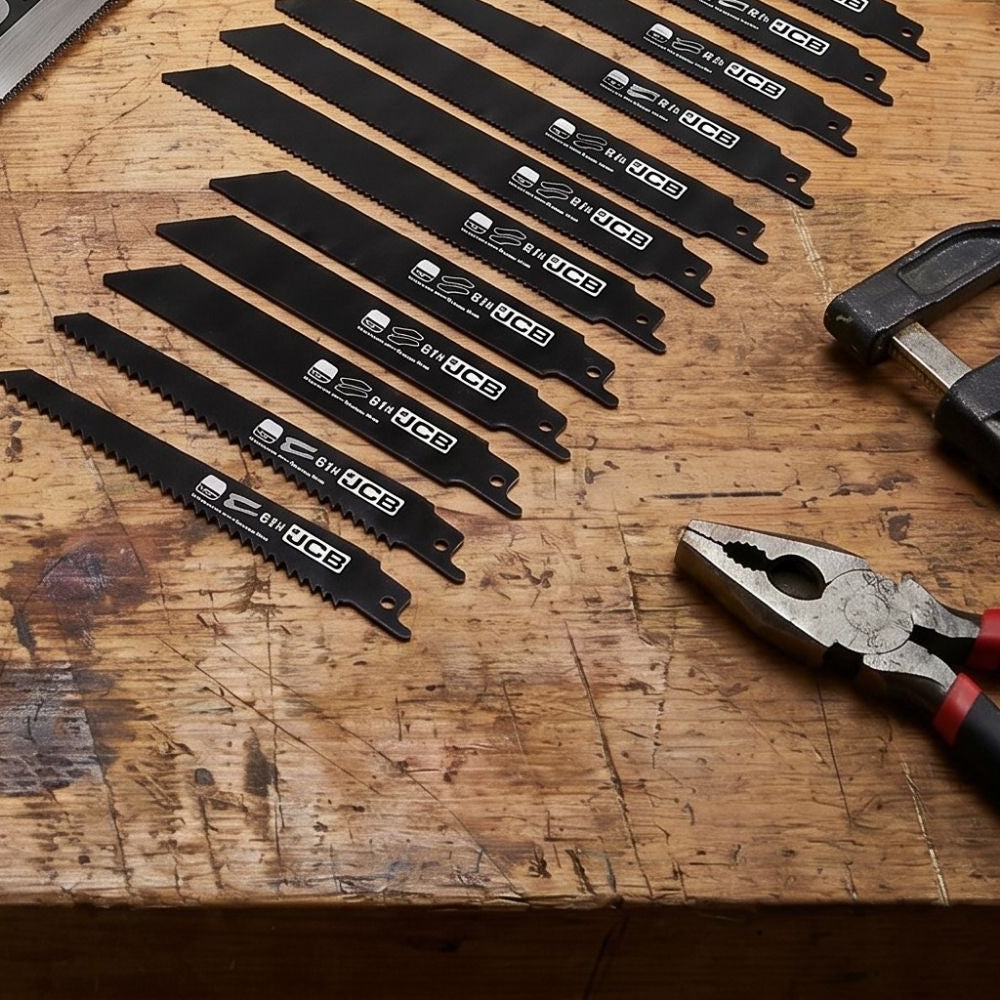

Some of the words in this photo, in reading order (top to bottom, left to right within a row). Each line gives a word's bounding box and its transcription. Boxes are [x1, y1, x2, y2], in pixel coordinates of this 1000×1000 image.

[771, 22, 827, 53] JCB
[727, 66, 783, 98] JCB
[681, 115, 737, 147] JCB
[628, 164, 684, 197] JCB
[593, 213, 650, 247] JCB
[546, 261, 604, 294] JCB
[493, 309, 552, 344] JCB
[444, 362, 503, 398] JCB
[394, 414, 454, 451] JCB
[341, 476, 401, 513] JCB
[286, 531, 347, 570] JCB
